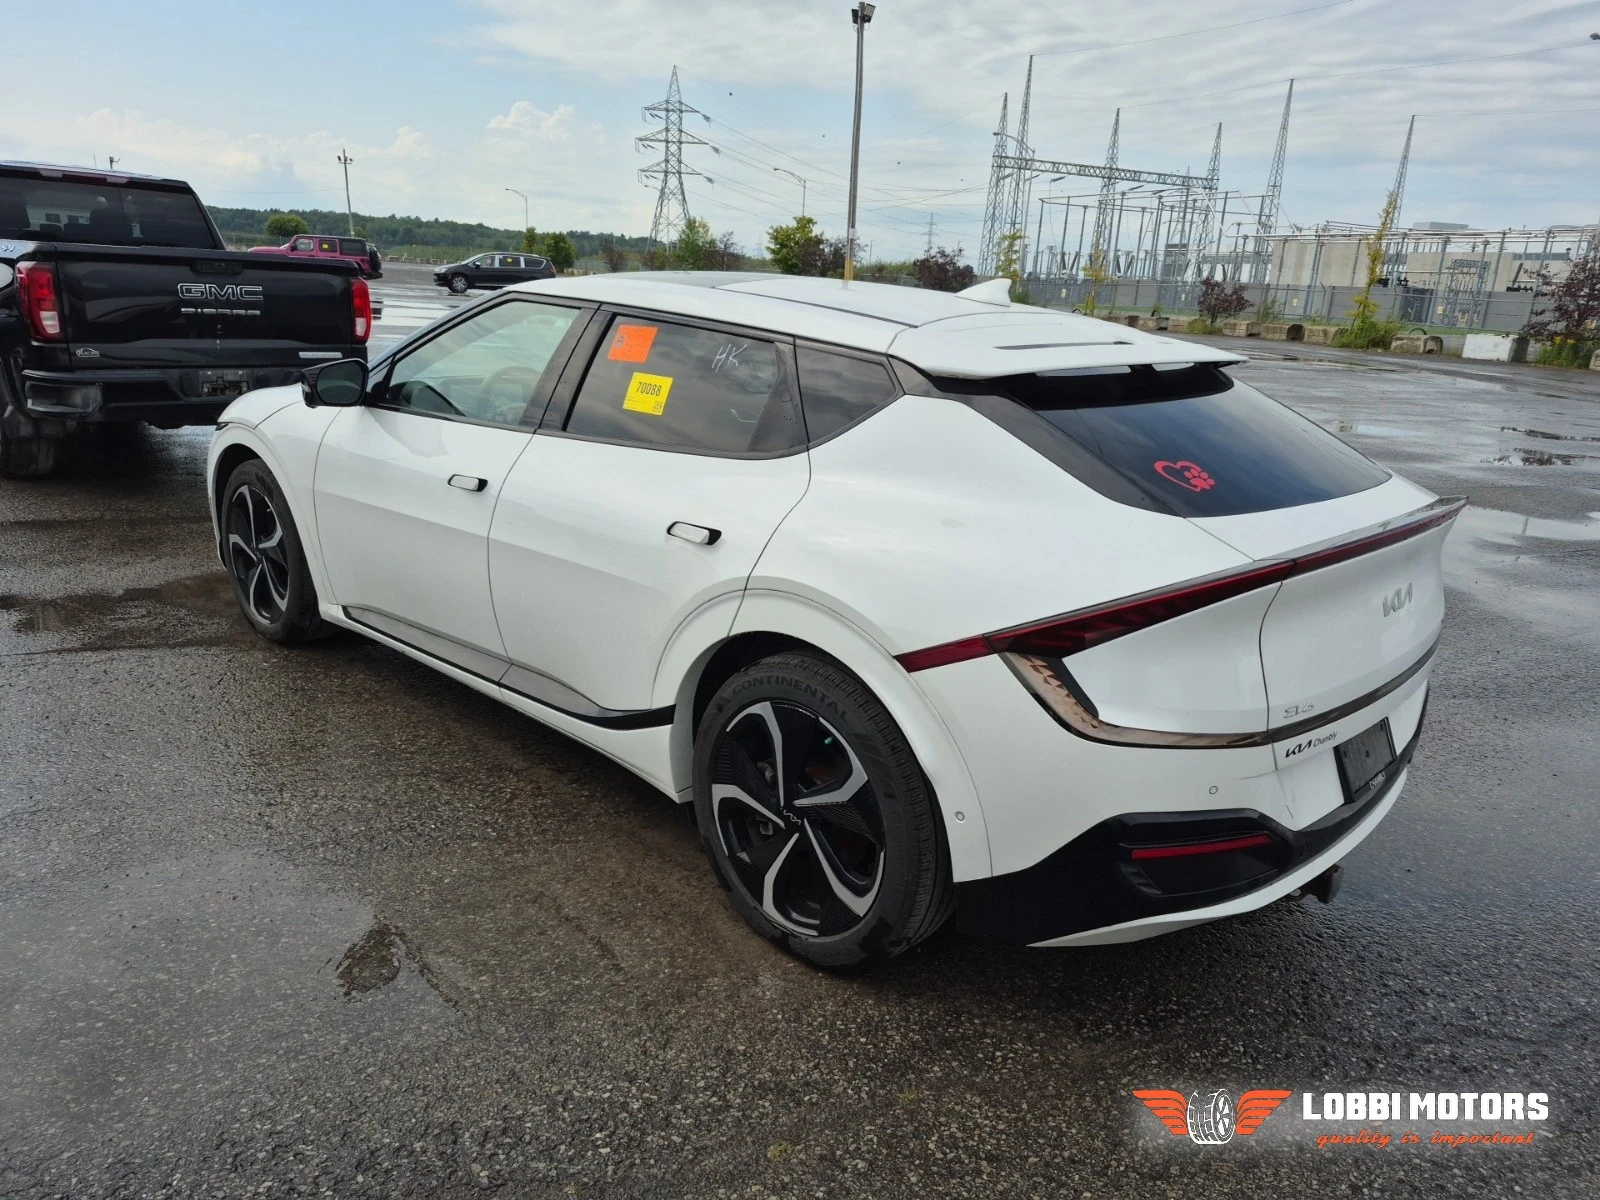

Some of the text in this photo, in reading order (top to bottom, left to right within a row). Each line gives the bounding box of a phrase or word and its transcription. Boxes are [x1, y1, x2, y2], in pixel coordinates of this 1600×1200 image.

[177, 283, 264, 301] GMC
[711, 343, 748, 373] HK
[636, 381, 663, 397] 70088
[1382, 582, 1413, 618] KIA
[732, 675, 850, 725] CONTINENTAL
[1285, 739, 1312, 758] KIA
